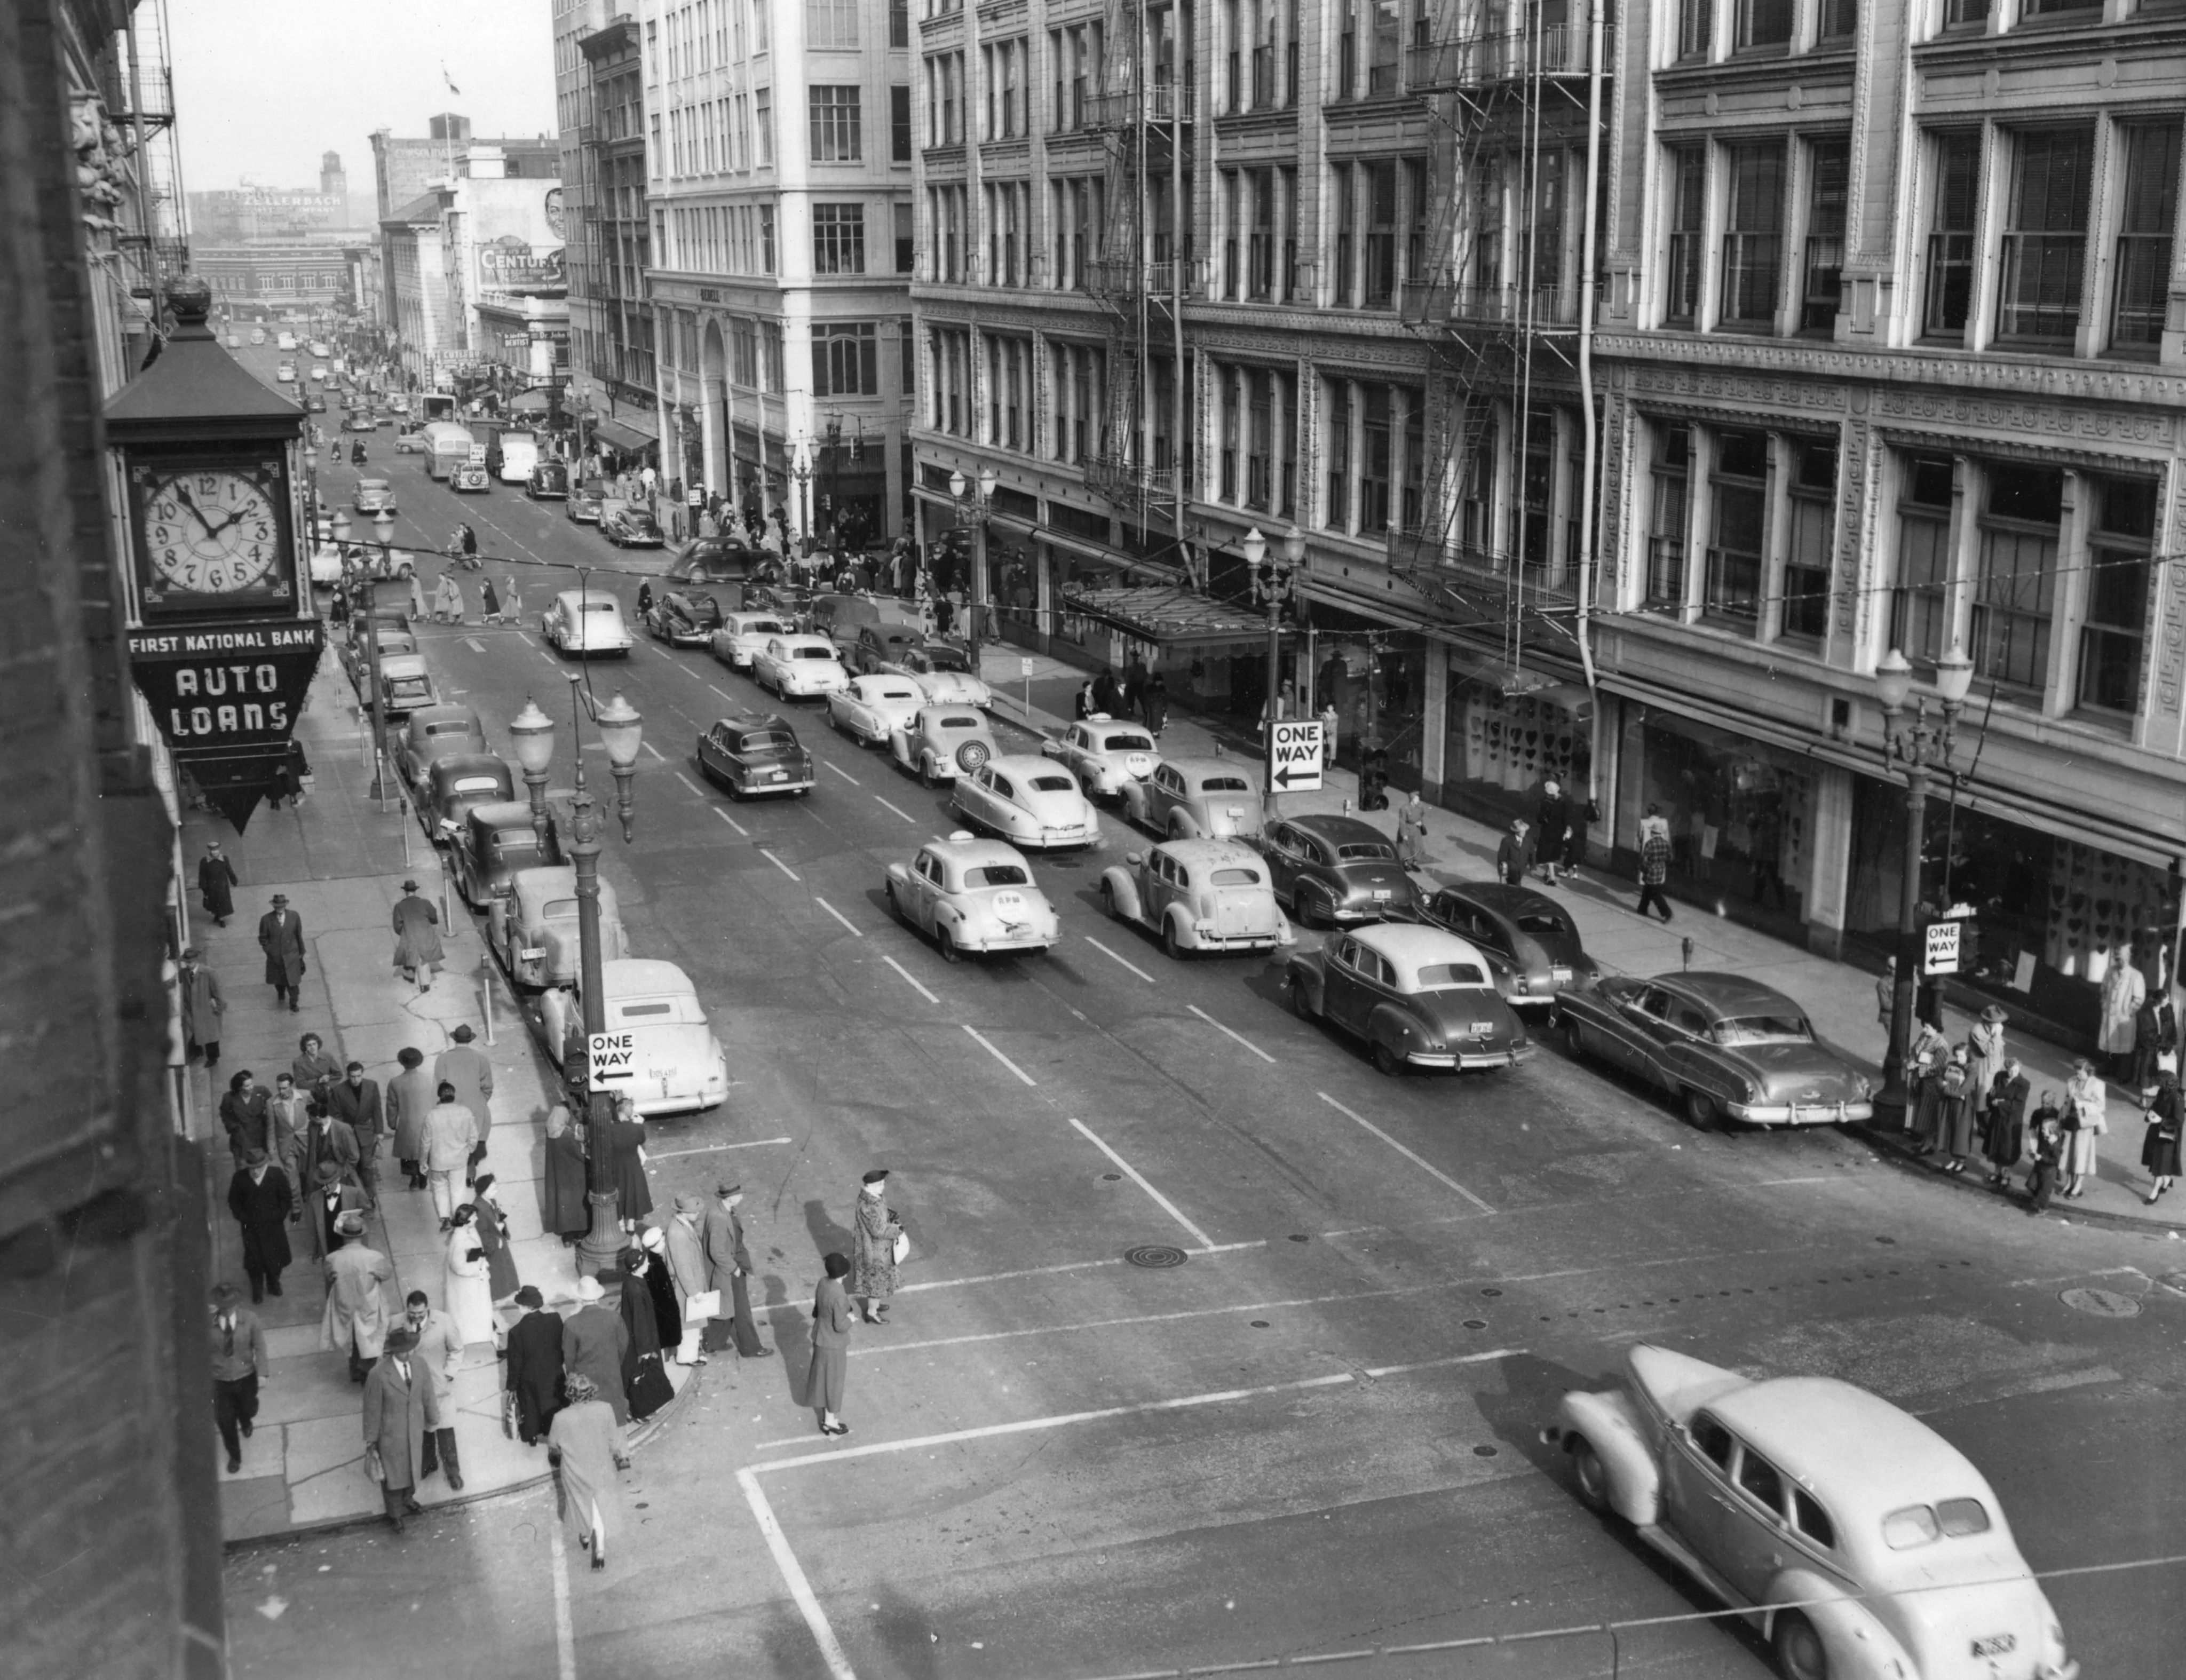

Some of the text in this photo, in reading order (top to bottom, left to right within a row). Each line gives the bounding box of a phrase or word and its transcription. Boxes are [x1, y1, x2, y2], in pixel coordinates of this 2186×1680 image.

[505, 338, 529, 347] DENTIST
[129, 629, 315, 653] FIRST NATIONAL BANK
[176, 664, 277, 696] AUTO
[170, 702, 288, 736] LOANS
[1277, 726, 1318, 743] ONE
[1276, 745, 1319, 763] WAY
[1929, 926, 1958, 939] ONE
[1928, 941, 1957, 953] WAY
[593, 1035, 633, 1050] ONE
[593, 1051, 633, 1067] WAY
